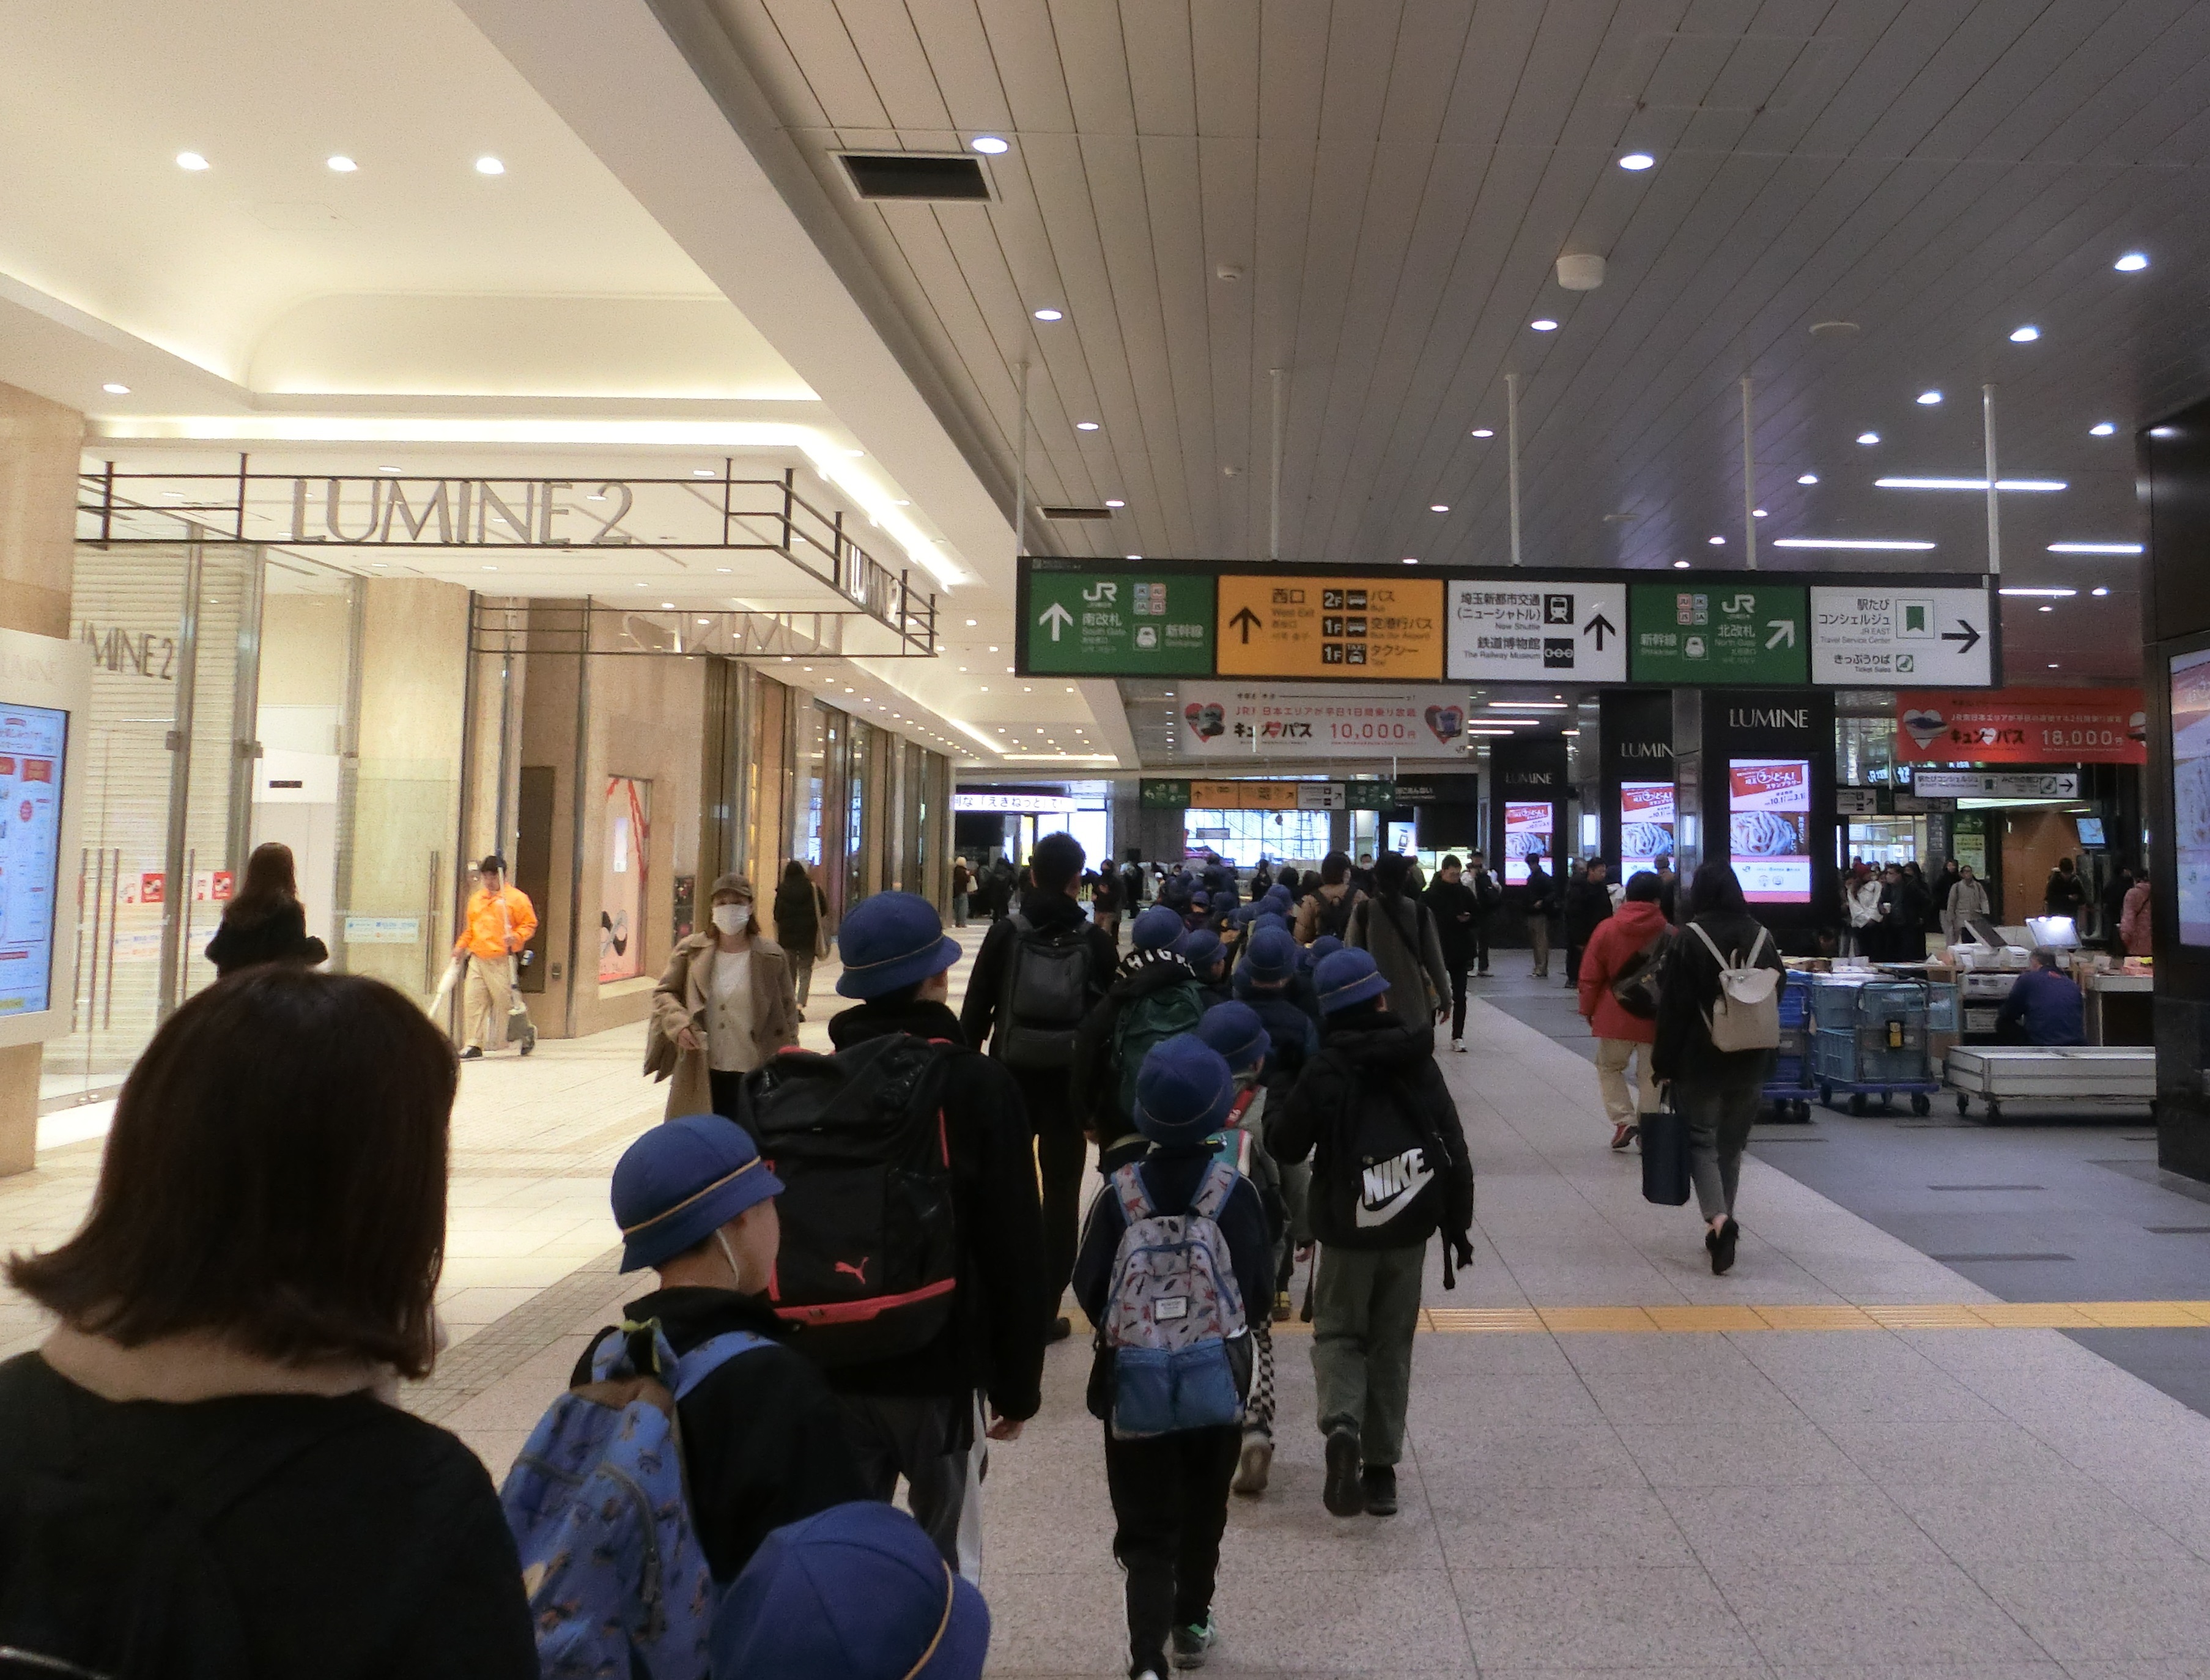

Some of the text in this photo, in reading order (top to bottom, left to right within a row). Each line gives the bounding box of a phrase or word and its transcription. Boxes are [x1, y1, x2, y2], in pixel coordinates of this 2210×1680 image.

[1082, 583, 1117, 602] JR
[1273, 589, 1304, 603] 西口
[1324, 591, 1342, 607] 2F
[1370, 590, 1394, 602] バス
[1461, 593, 1540, 605] 埼玉新都市交通
[1721, 594, 1754, 613] JR
[1857, 599, 1890, 610] 駅たび
[1819, 614, 1890, 625] コンシェルジュ
[1325, 620, 1342, 634] 1F
[1718, 624, 1755, 637] 北改札
[1477, 637, 1540, 649] 鉄道博物館
[1325, 646, 1342, 661] 1F
[1371, 645, 1418, 656] タクシー
[1729, 709, 1808, 728] LUMINE
[1362, 1147, 1425, 1206] NIKE
